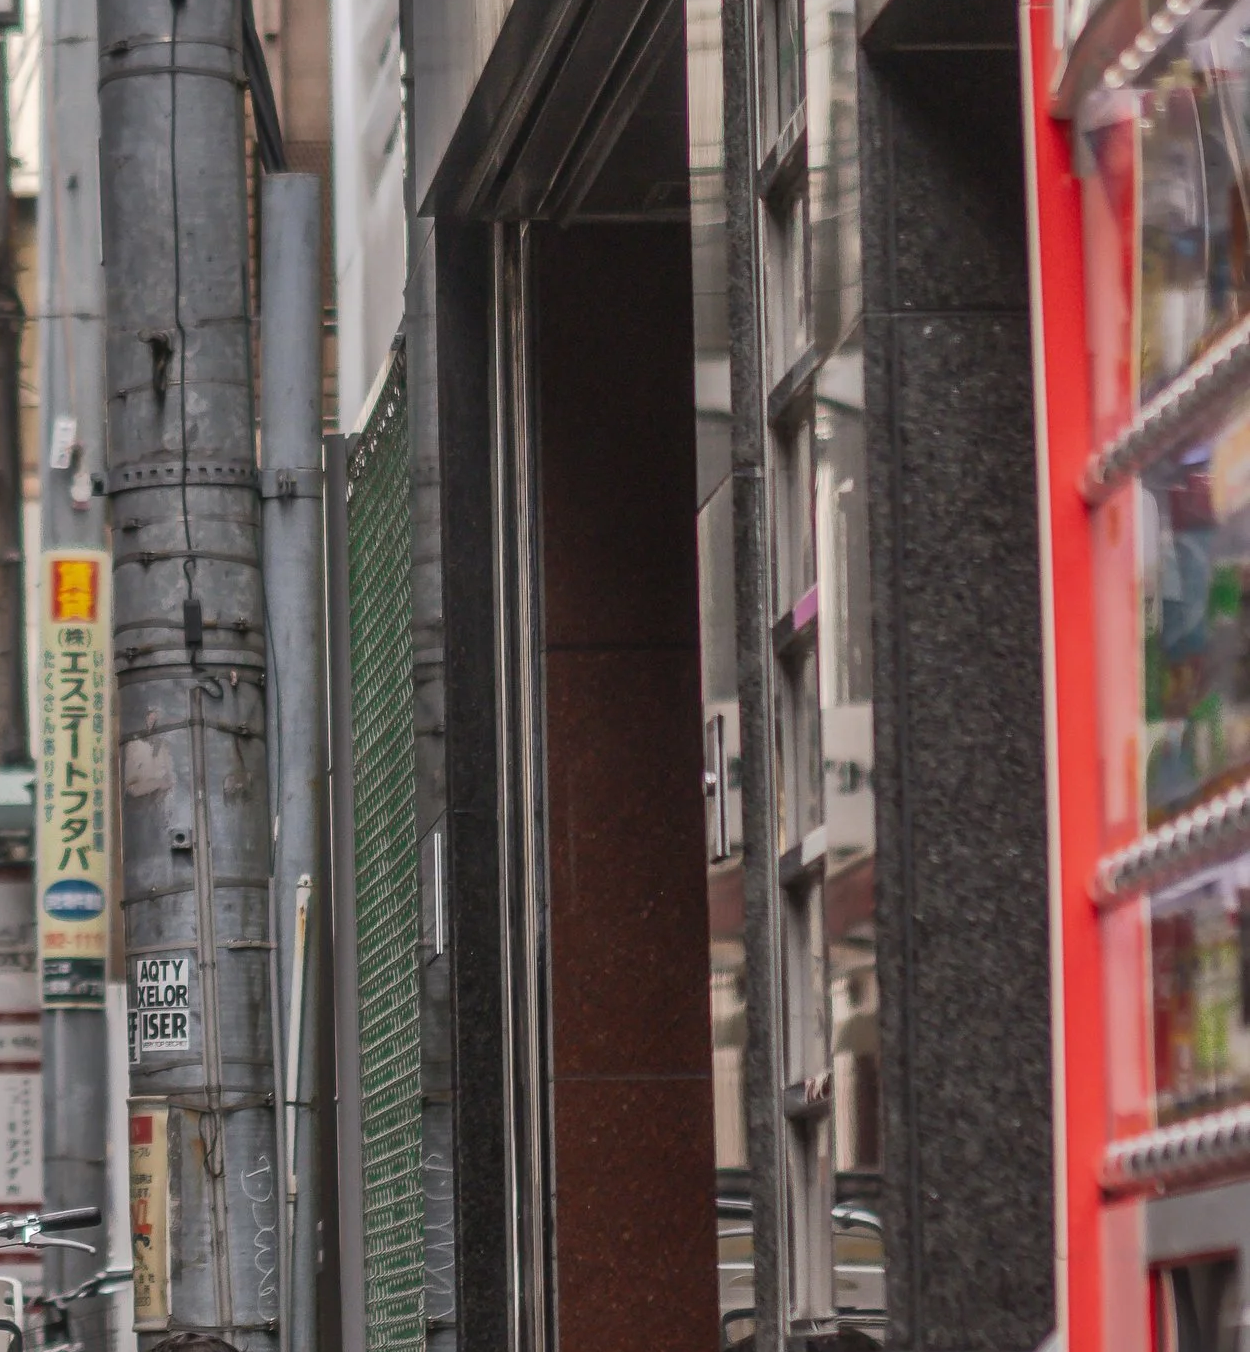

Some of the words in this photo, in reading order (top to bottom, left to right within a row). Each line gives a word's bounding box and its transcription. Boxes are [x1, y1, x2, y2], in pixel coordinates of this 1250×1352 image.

[140, 960, 184, 983] AQTY
[138, 984, 188, 1007] XELOR
[143, 1012, 187, 1040] ISER
